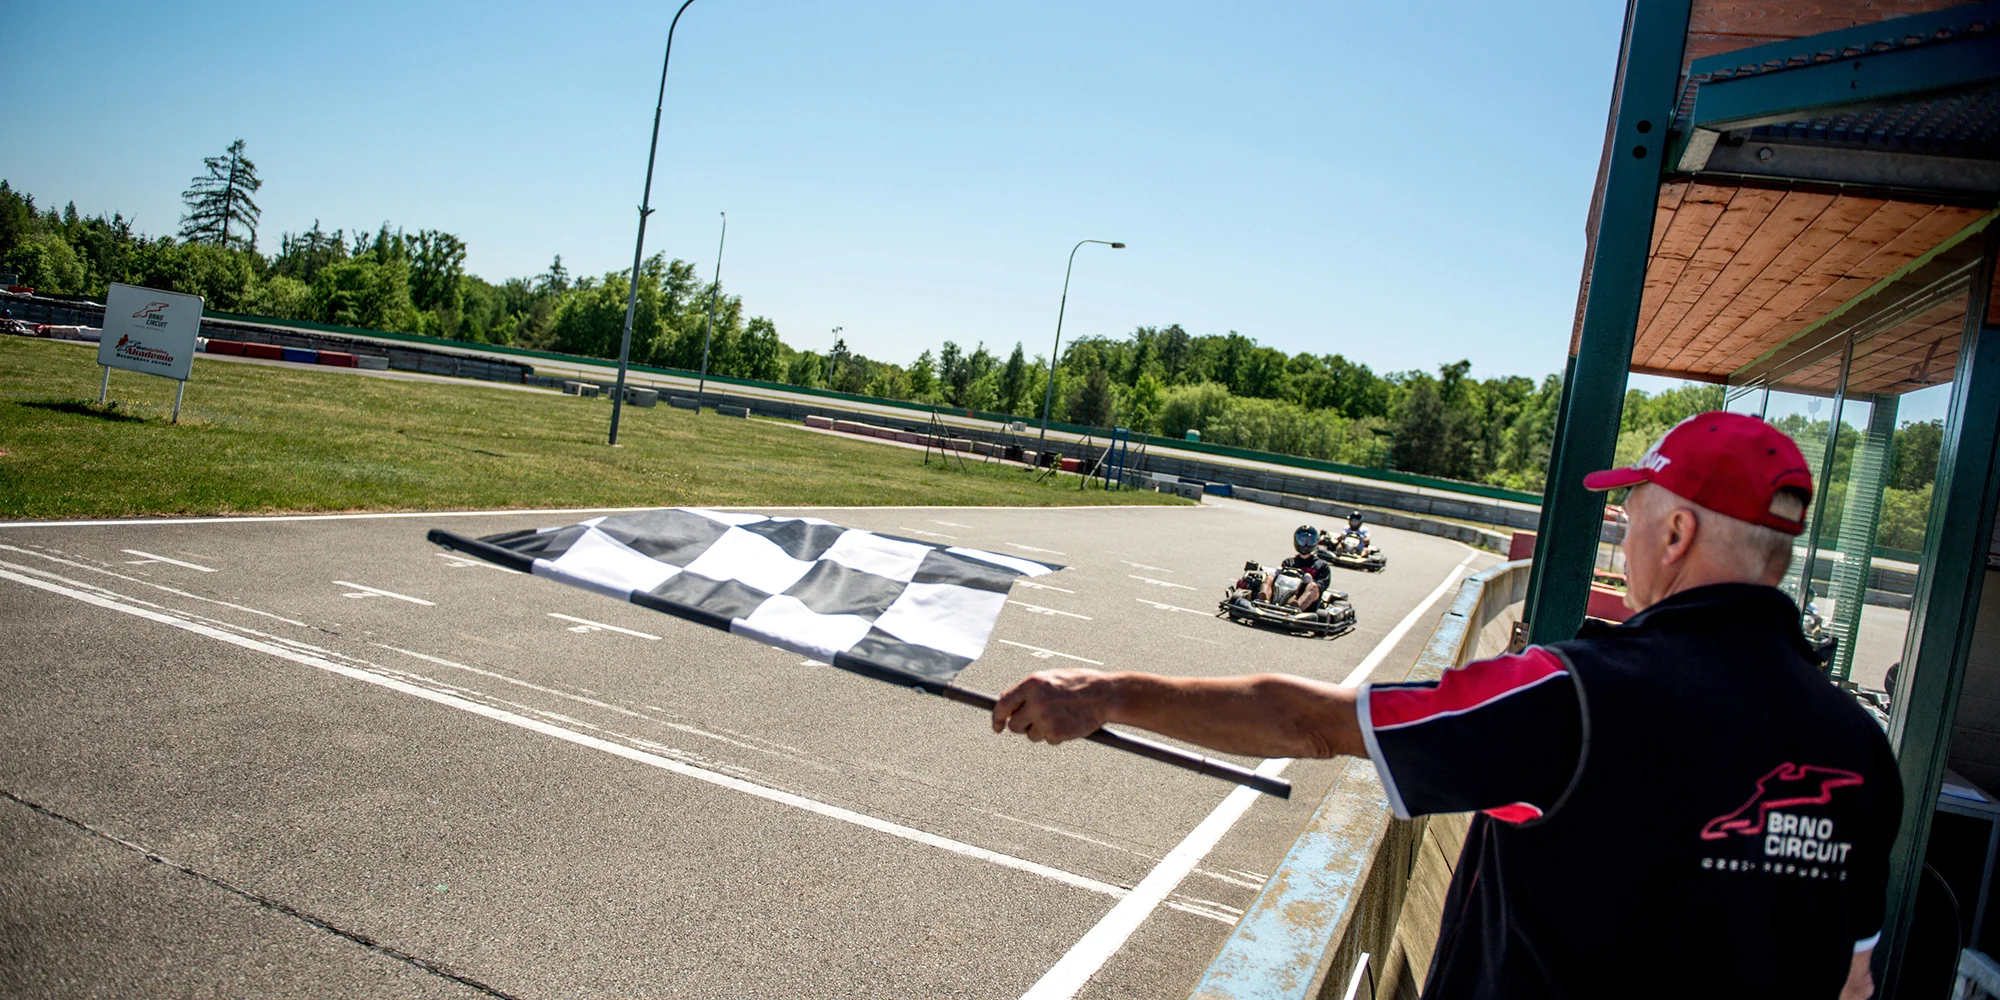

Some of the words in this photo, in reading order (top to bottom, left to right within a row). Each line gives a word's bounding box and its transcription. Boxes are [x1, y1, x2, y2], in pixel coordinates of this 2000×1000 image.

[146, 320, 168, 328] CIRCUIT
[148, 313, 164, 321] BRNO
[1767, 811, 1834, 841] BRNO
[1764, 834, 1852, 864] CIRCUIT
